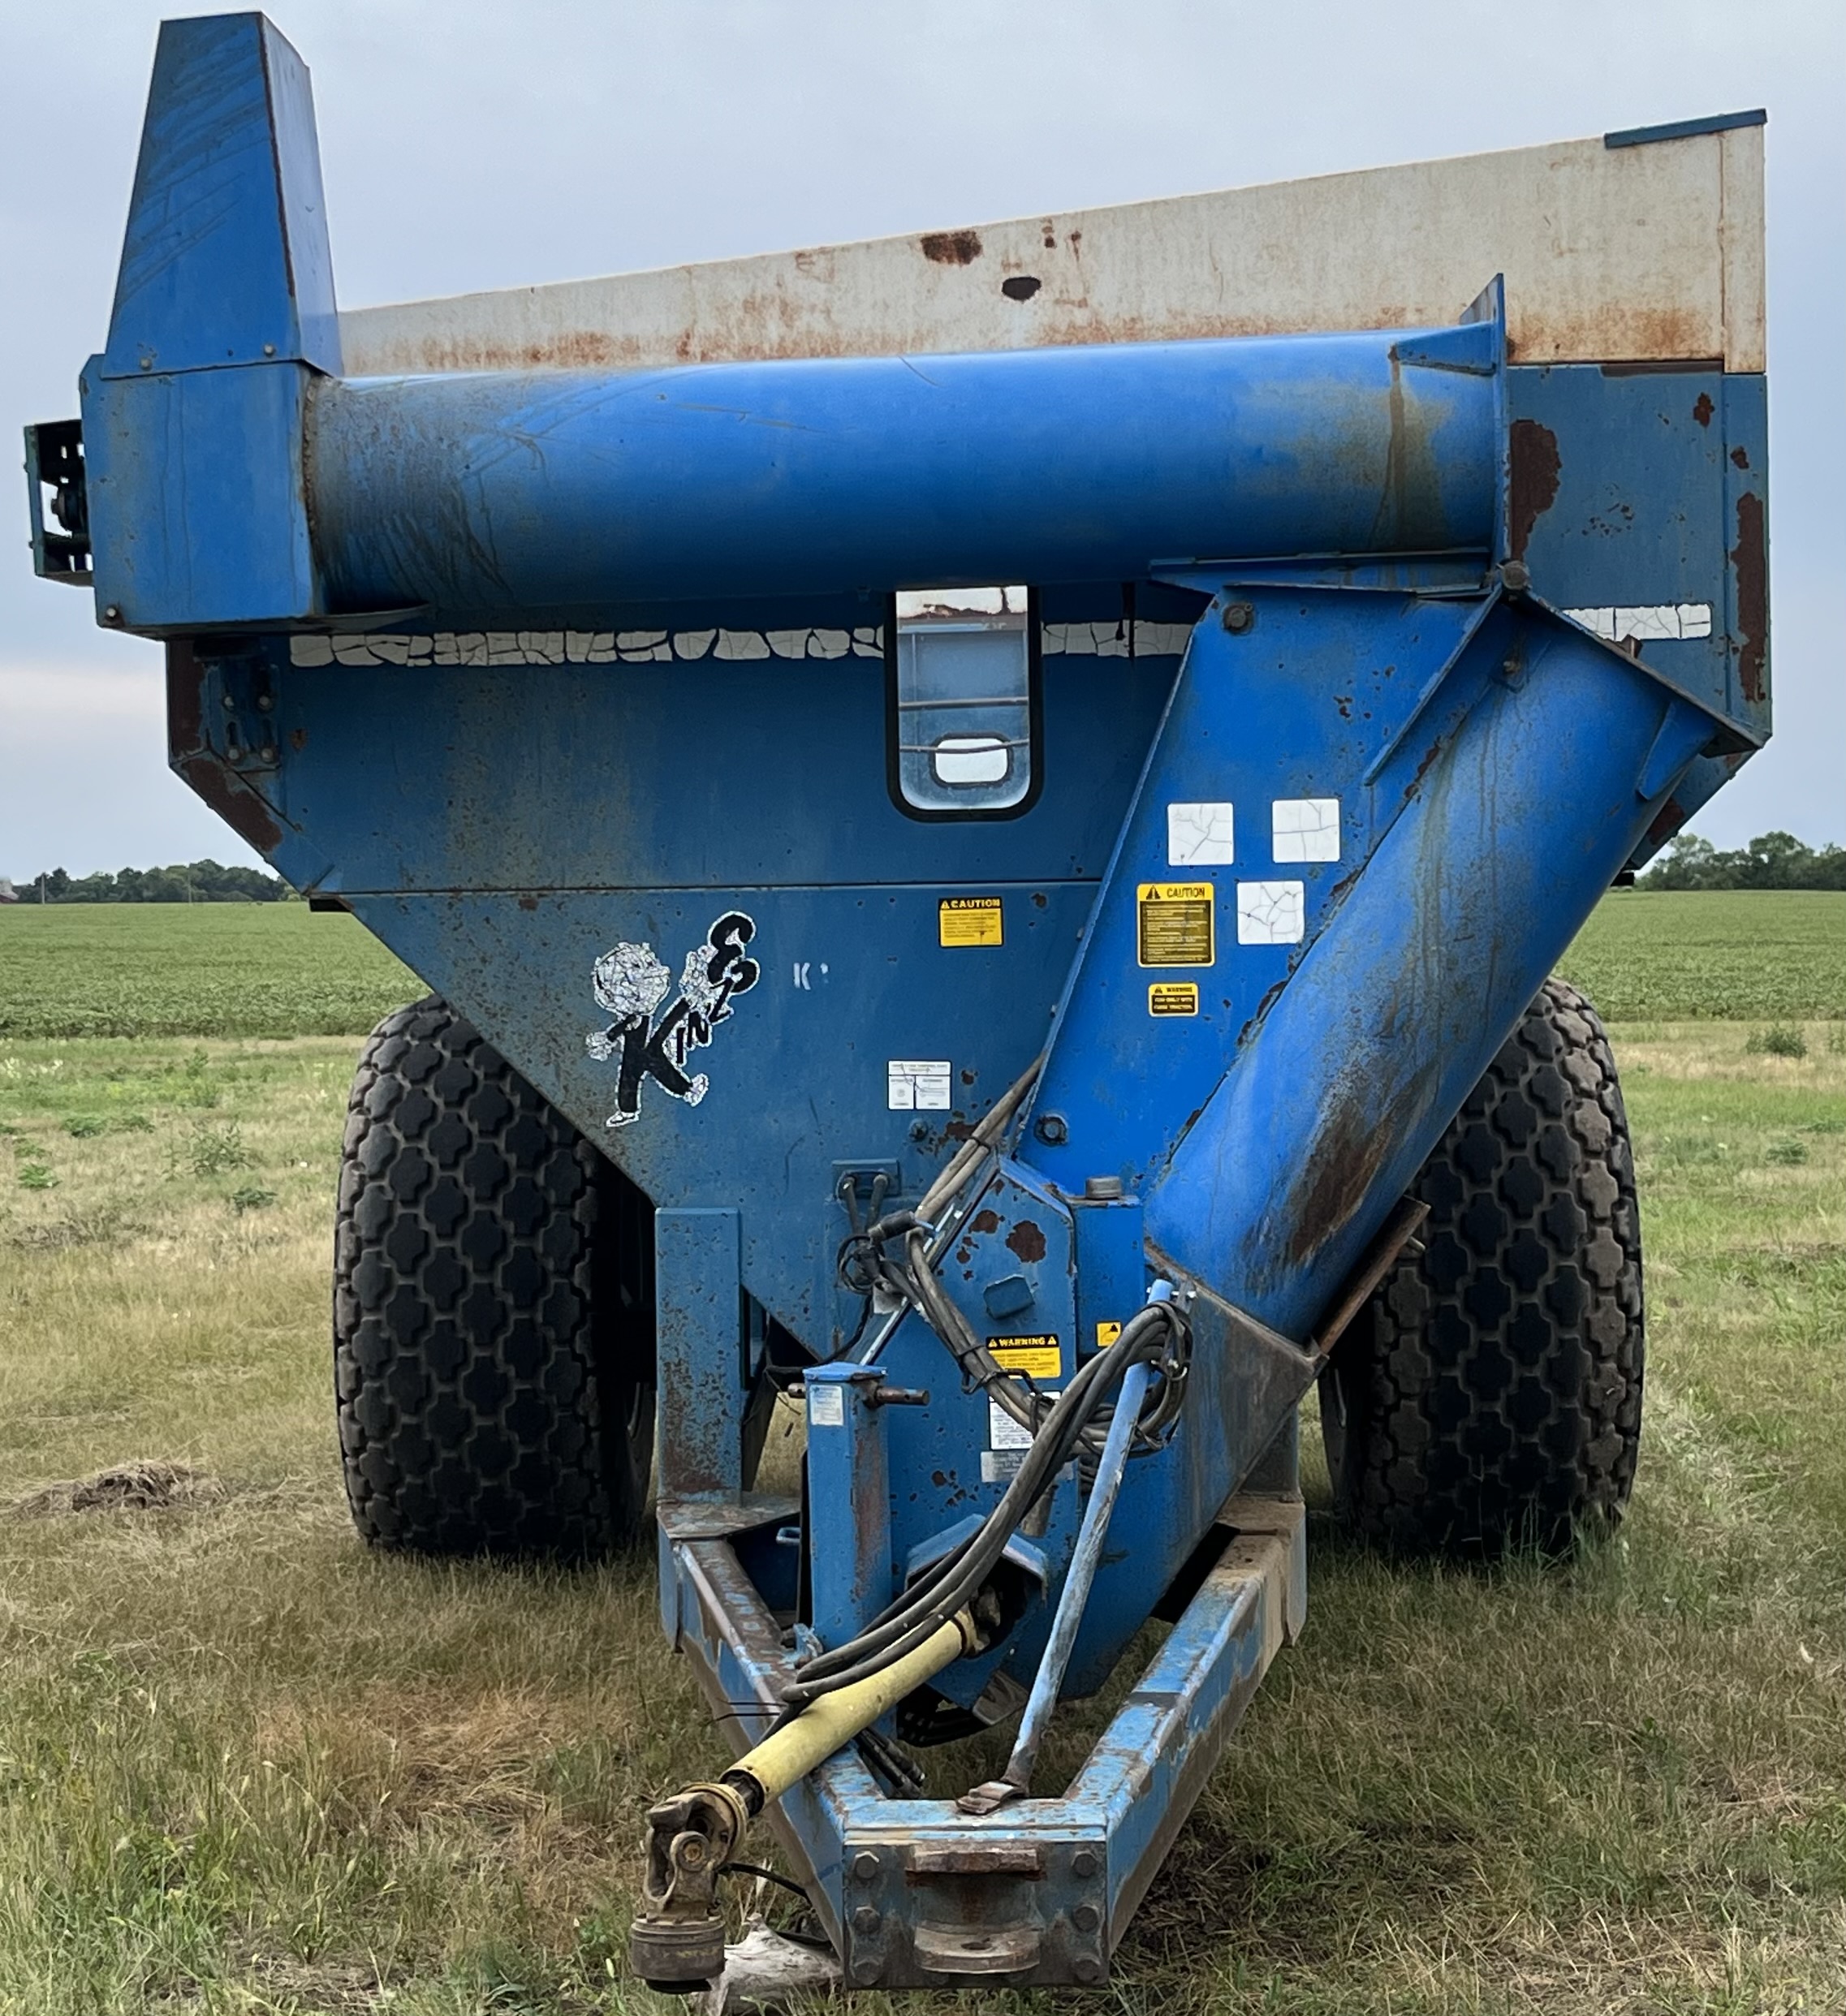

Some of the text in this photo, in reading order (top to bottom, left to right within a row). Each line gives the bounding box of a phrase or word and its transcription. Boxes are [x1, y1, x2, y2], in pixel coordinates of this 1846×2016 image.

[1167, 887, 1206, 898] CAUTION
[951, 898, 1000, 908] CAUTION
[998, 1336, 1046, 1346] WARNING
